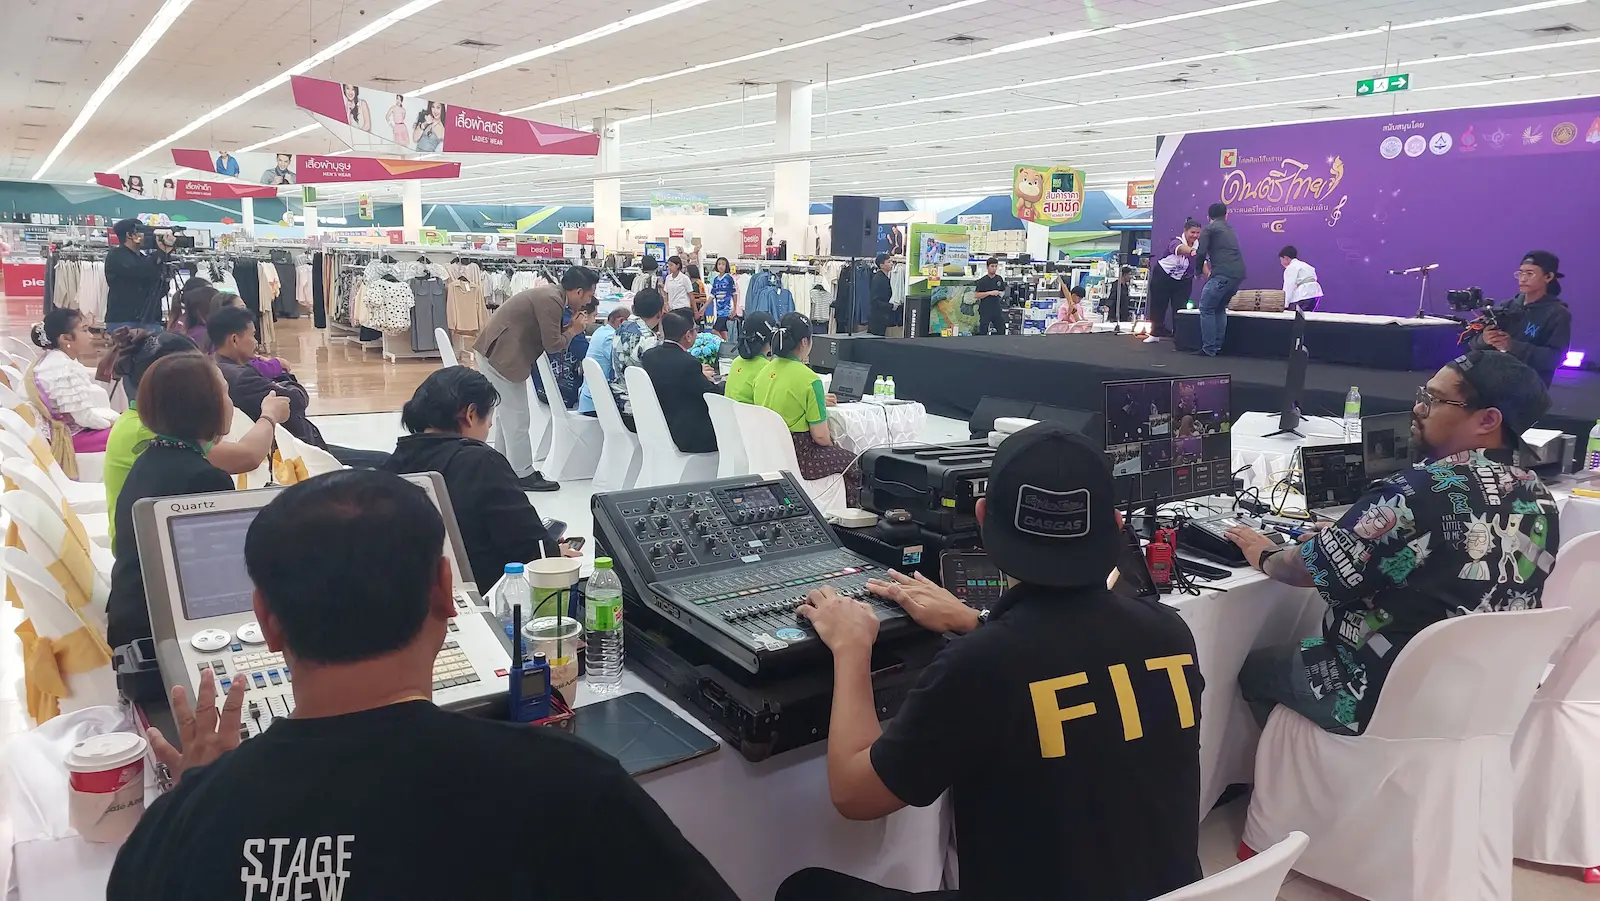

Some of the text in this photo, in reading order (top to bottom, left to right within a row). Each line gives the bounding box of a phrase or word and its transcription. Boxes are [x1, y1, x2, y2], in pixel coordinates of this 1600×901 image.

[455, 111, 504, 135] เสื้อผ้าสตรี
[1382, 120, 1425, 132] สนับสนุนโดย
[471, 135, 504, 146] LADIES' WEAR
[305, 157, 352, 173] เสื้อผ้าบุรุษ
[185, 182, 212, 191] เสื้อผ้าเด็ก
[1221, 158, 1343, 205] ดนตรีไทย
[1045, 188, 1079, 200] สินค้าราคา
[1043, 199, 1080, 213] สมาชิก
[22, 278, 45, 288] ple
[170, 500, 217, 513] Quartz
[1023, 515, 1084, 531] GASGAS
[1441, 520, 1462, 531] LITTLE
[1320, 525, 1364, 587] ARGUING
[1028, 653, 1195, 759] FIT
[240, 834, 356, 883] STAGE
